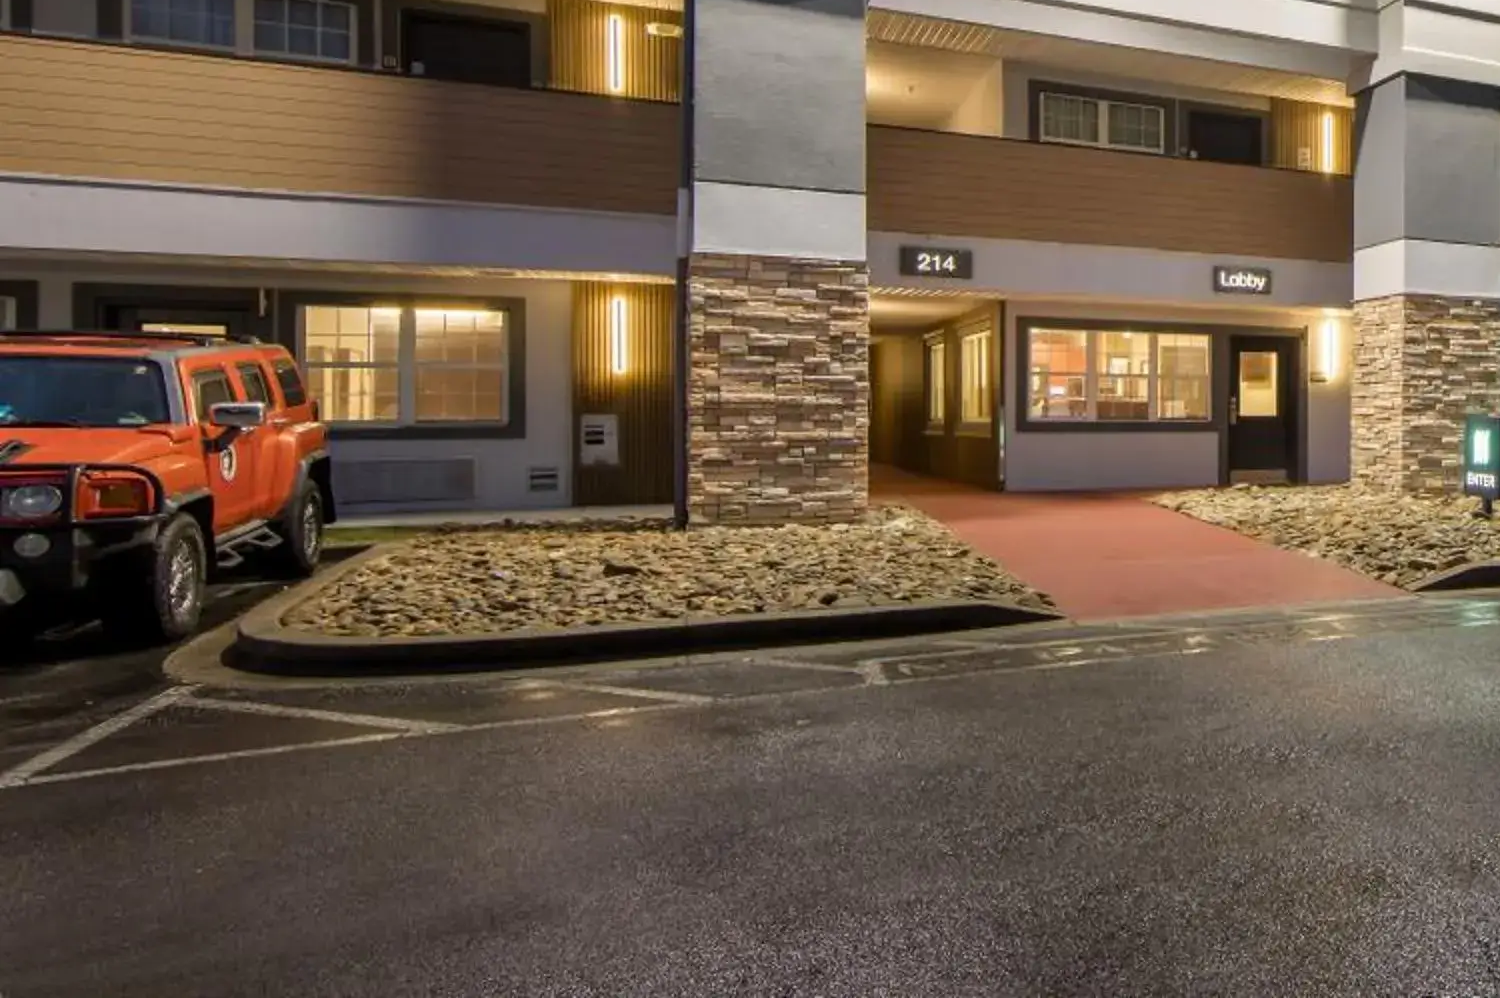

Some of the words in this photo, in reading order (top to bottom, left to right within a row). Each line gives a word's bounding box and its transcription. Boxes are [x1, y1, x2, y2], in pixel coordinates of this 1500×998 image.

[917, 252, 957, 272] 214
[1220, 270, 1266, 291] Lobby
[1467, 471, 1496, 489] ENTER
